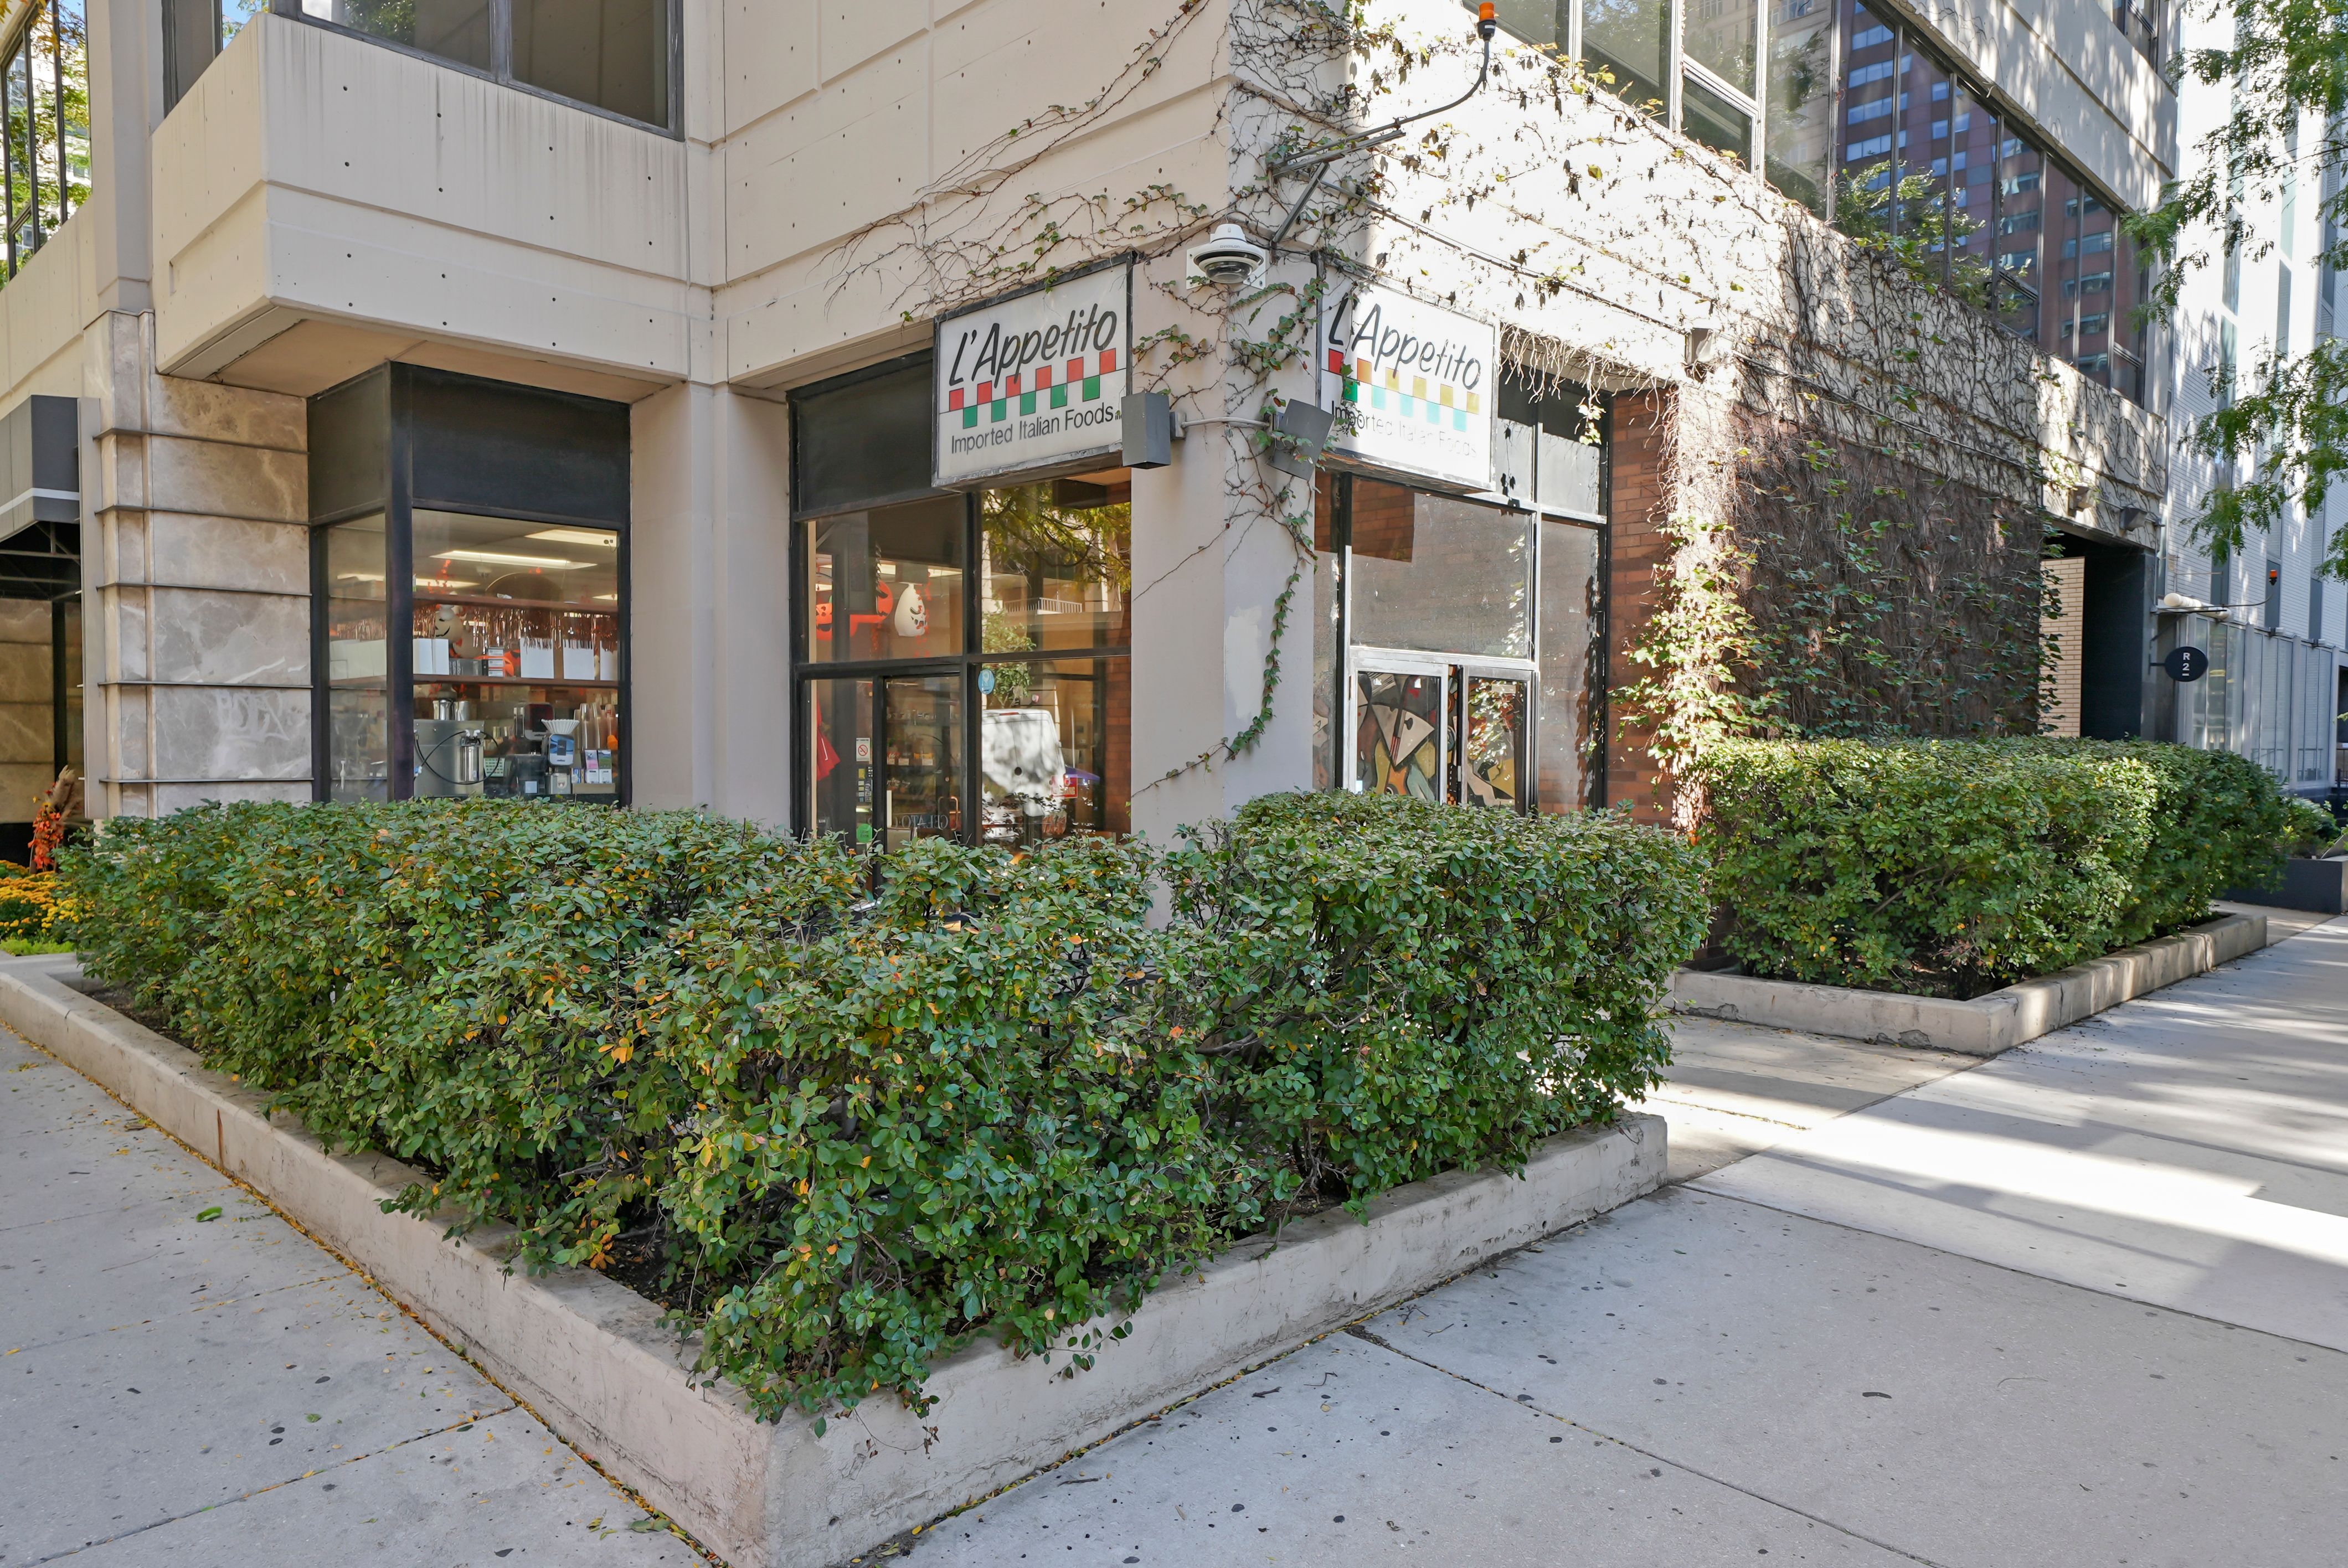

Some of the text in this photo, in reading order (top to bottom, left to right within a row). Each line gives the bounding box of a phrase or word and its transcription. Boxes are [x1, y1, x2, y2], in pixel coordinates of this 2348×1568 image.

[949, 303, 1118, 389] L'Appetito
[951, 424, 1013, 455] Imported
[1019, 416, 1059, 441] Italian
[1065, 402, 1114, 431] Foods
